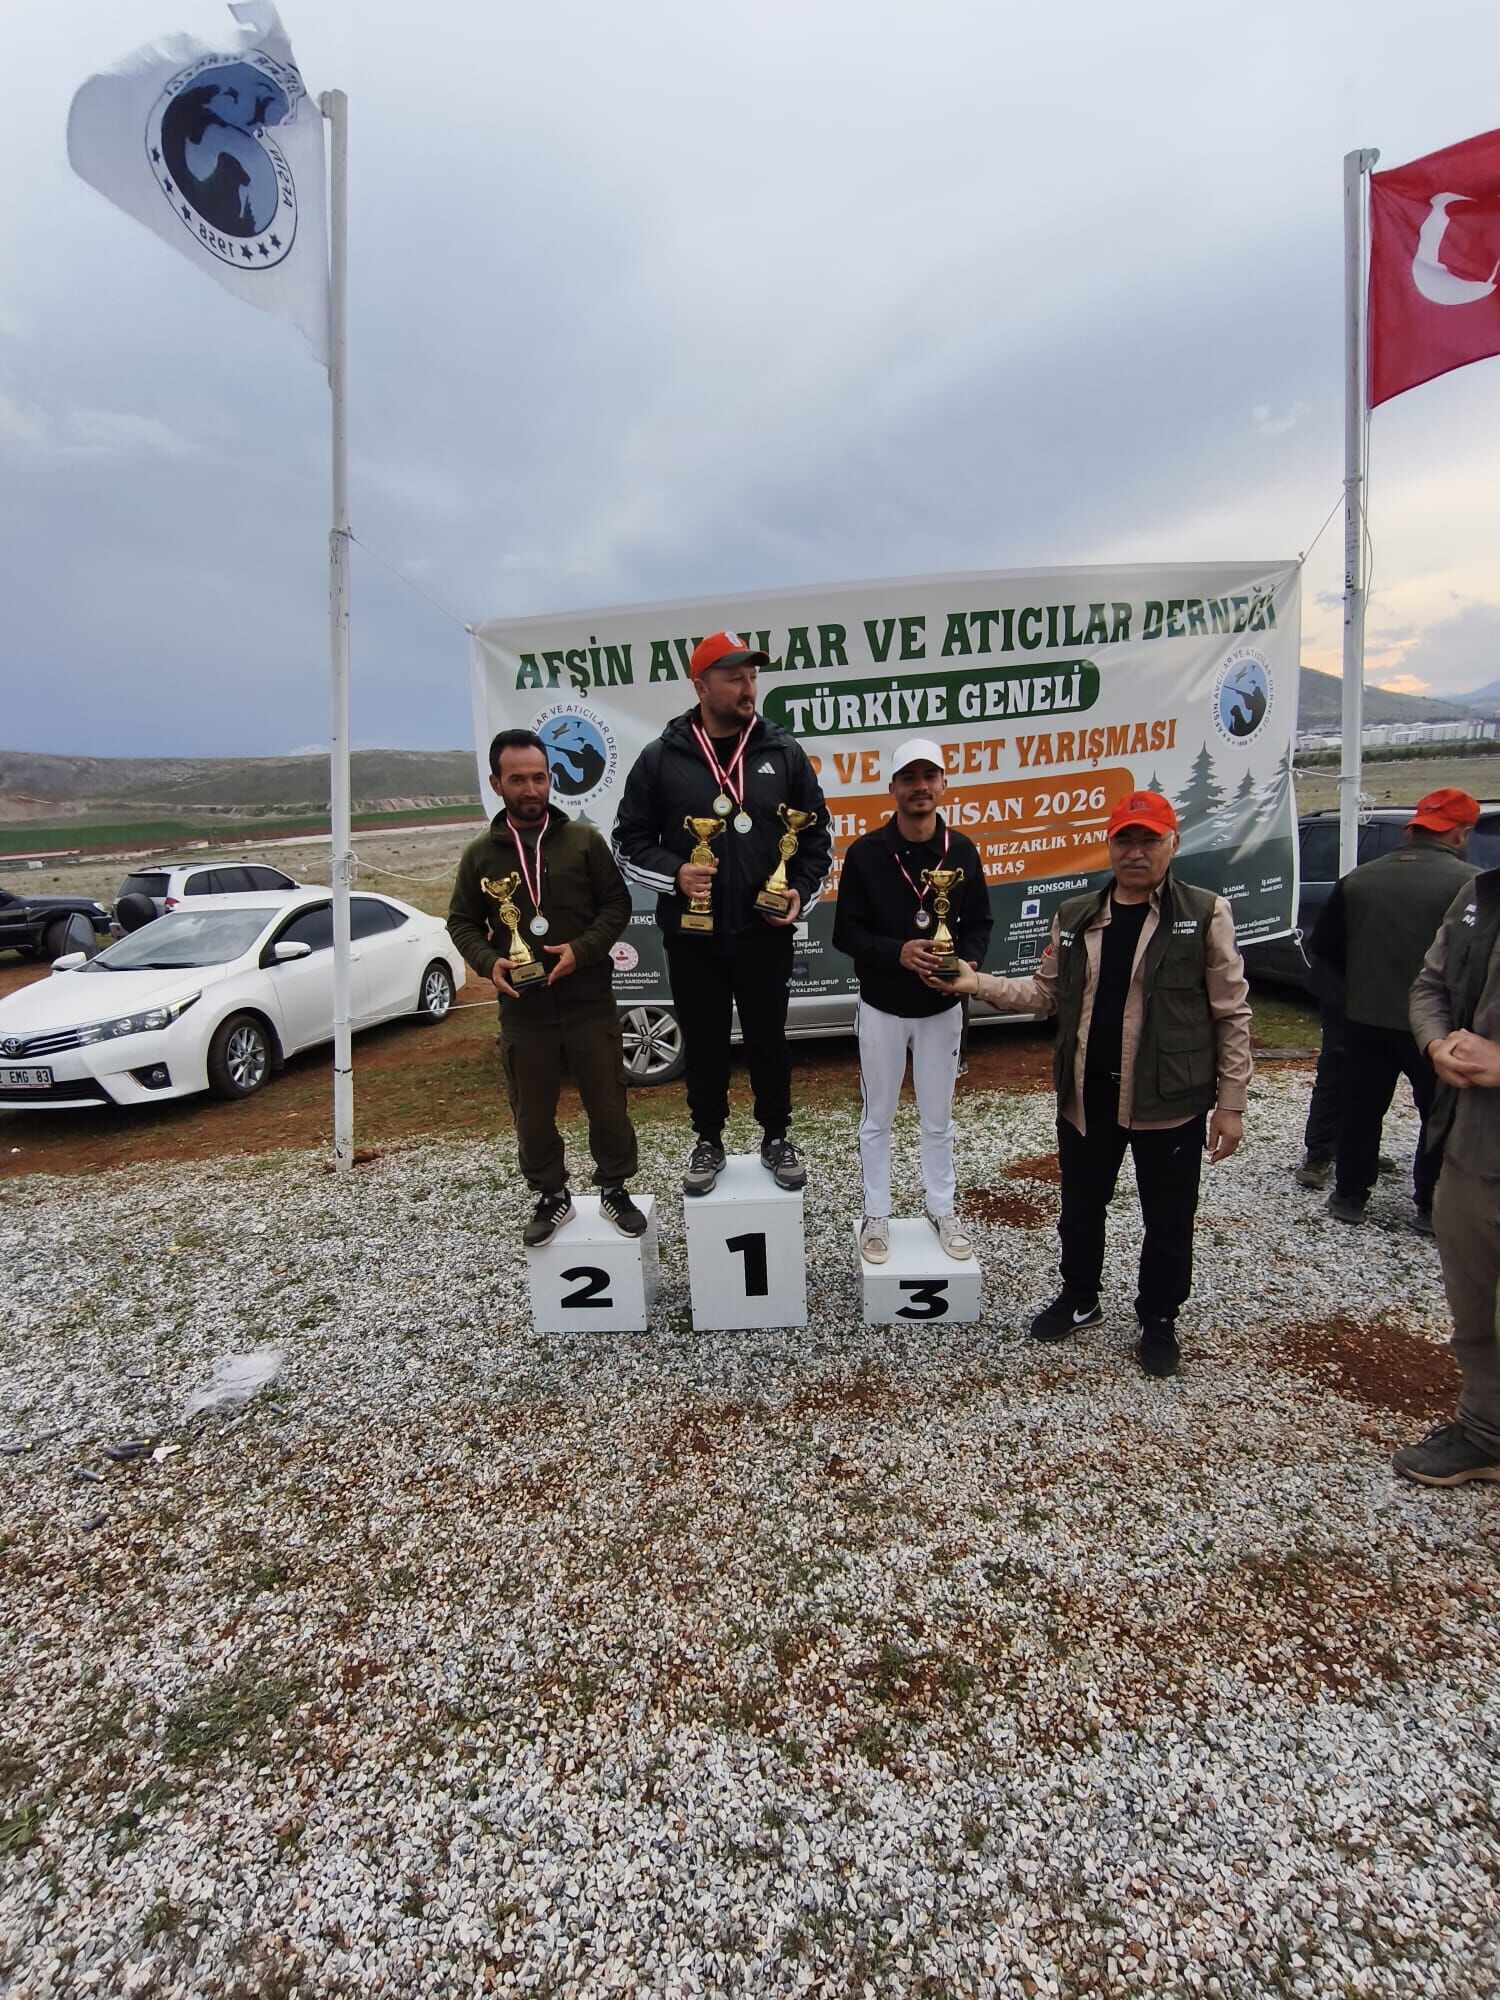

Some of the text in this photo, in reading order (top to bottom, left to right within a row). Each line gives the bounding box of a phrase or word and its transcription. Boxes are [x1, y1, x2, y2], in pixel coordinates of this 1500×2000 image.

[516, 635, 634, 698] AFŞİN
[864, 616, 926, 662] VE
[941, 601, 1133, 656] ATICILAR
[1142, 584, 1280, 641] DERNEĞİ
[784, 664, 1084, 733] TÜRKİYE GENELİ
[550, 704, 564, 715] VE
[566, 704, 610, 735] ATICILAR
[832, 750, 880, 784] VE
[942, 738, 1006, 776] EET
[1016, 718, 1178, 768] YARIŞMASI
[1034, 786, 1106, 817] 2026
[986, 834, 1066, 857] MEZARLIK
[1027, 878, 1088, 894] SPONSORLAR
[10, 1070, 30, 1084] EMG
[36, 1070, 50, 1083] 83
[725, 1232, 769, 1296] 1
[560, 1266, 614, 1308] 2
[894, 1280, 950, 1320] 3
